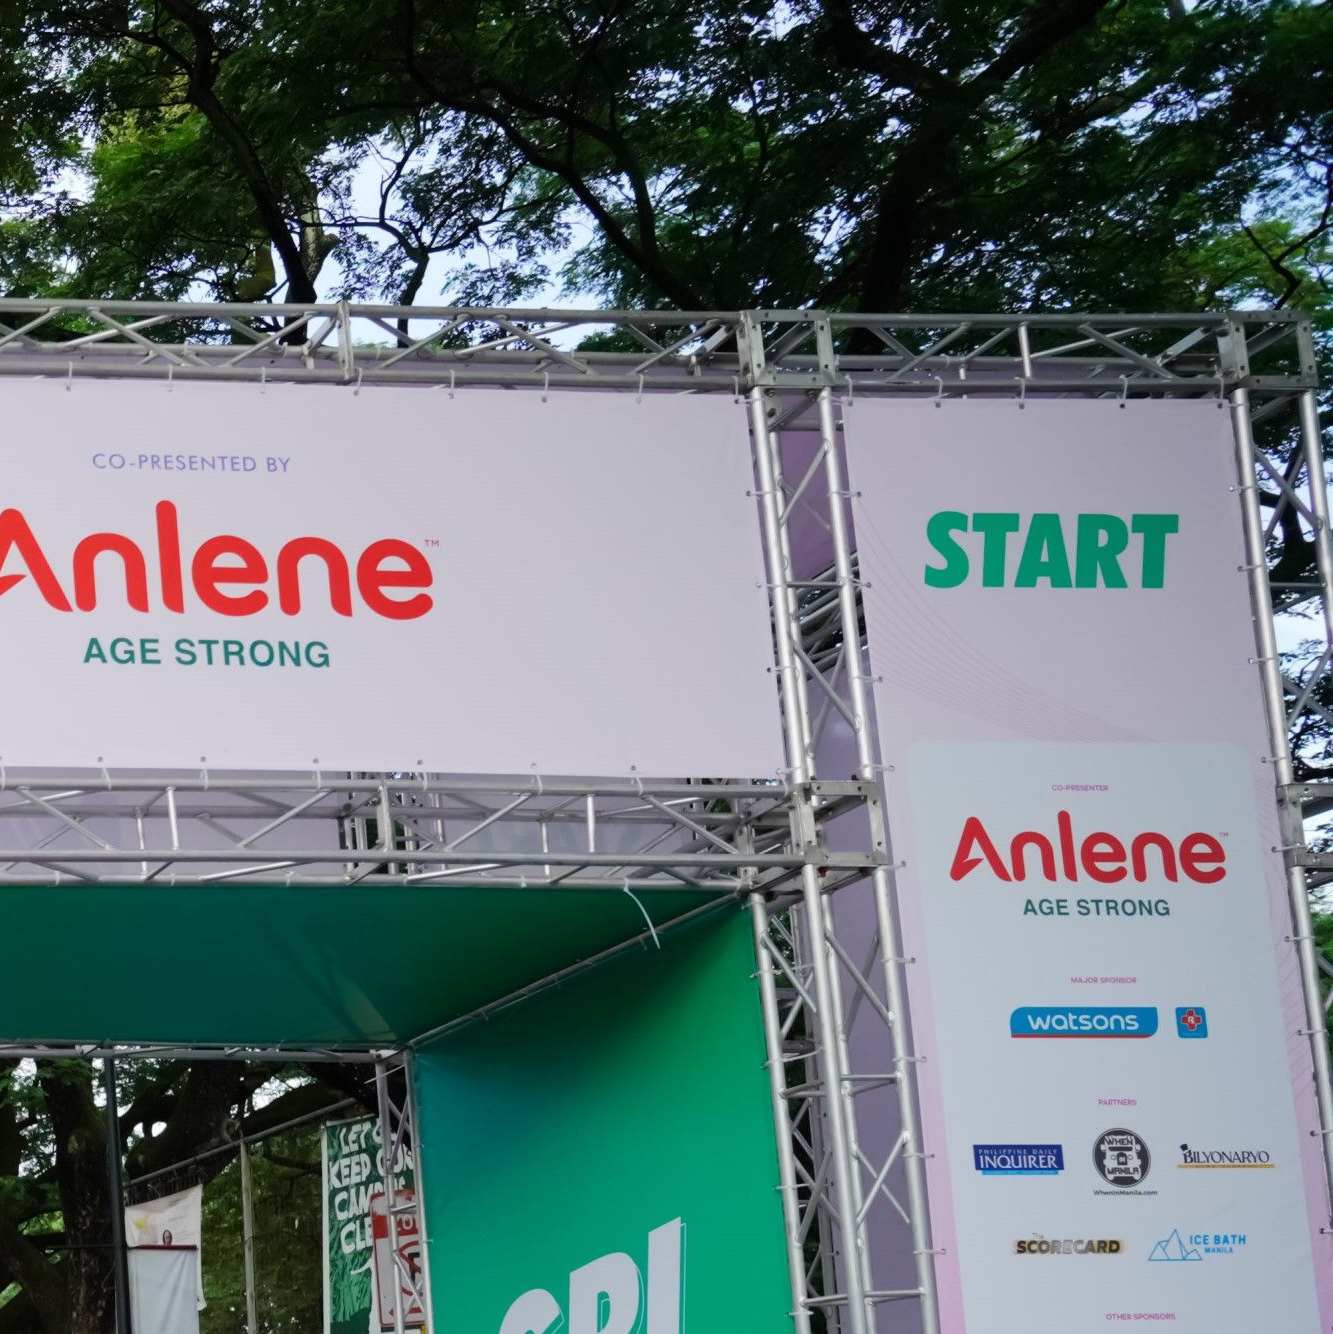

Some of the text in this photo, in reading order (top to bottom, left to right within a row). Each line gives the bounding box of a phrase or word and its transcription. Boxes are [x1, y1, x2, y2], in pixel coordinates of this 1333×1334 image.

[92, 453, 291, 473] CO-PRESENTED BY
[924, 511, 1179, 589] START
[84, 637, 331, 668] AGE STRONG
[949, 810, 1227, 884] Anlene
[1023, 899, 1171, 917] AGE STRONG
[1027, 1013, 1139, 1031] watsons
[979, 1155, 1059, 1169] INQUIRER
[1183, 1150, 1270, 1164] BILYONARYO
[329, 1152, 372, 1188] KEEP
[1017, 1240, 1121, 1254] SCORECARD
[1189, 1234, 1247, 1245] ICE BATH
